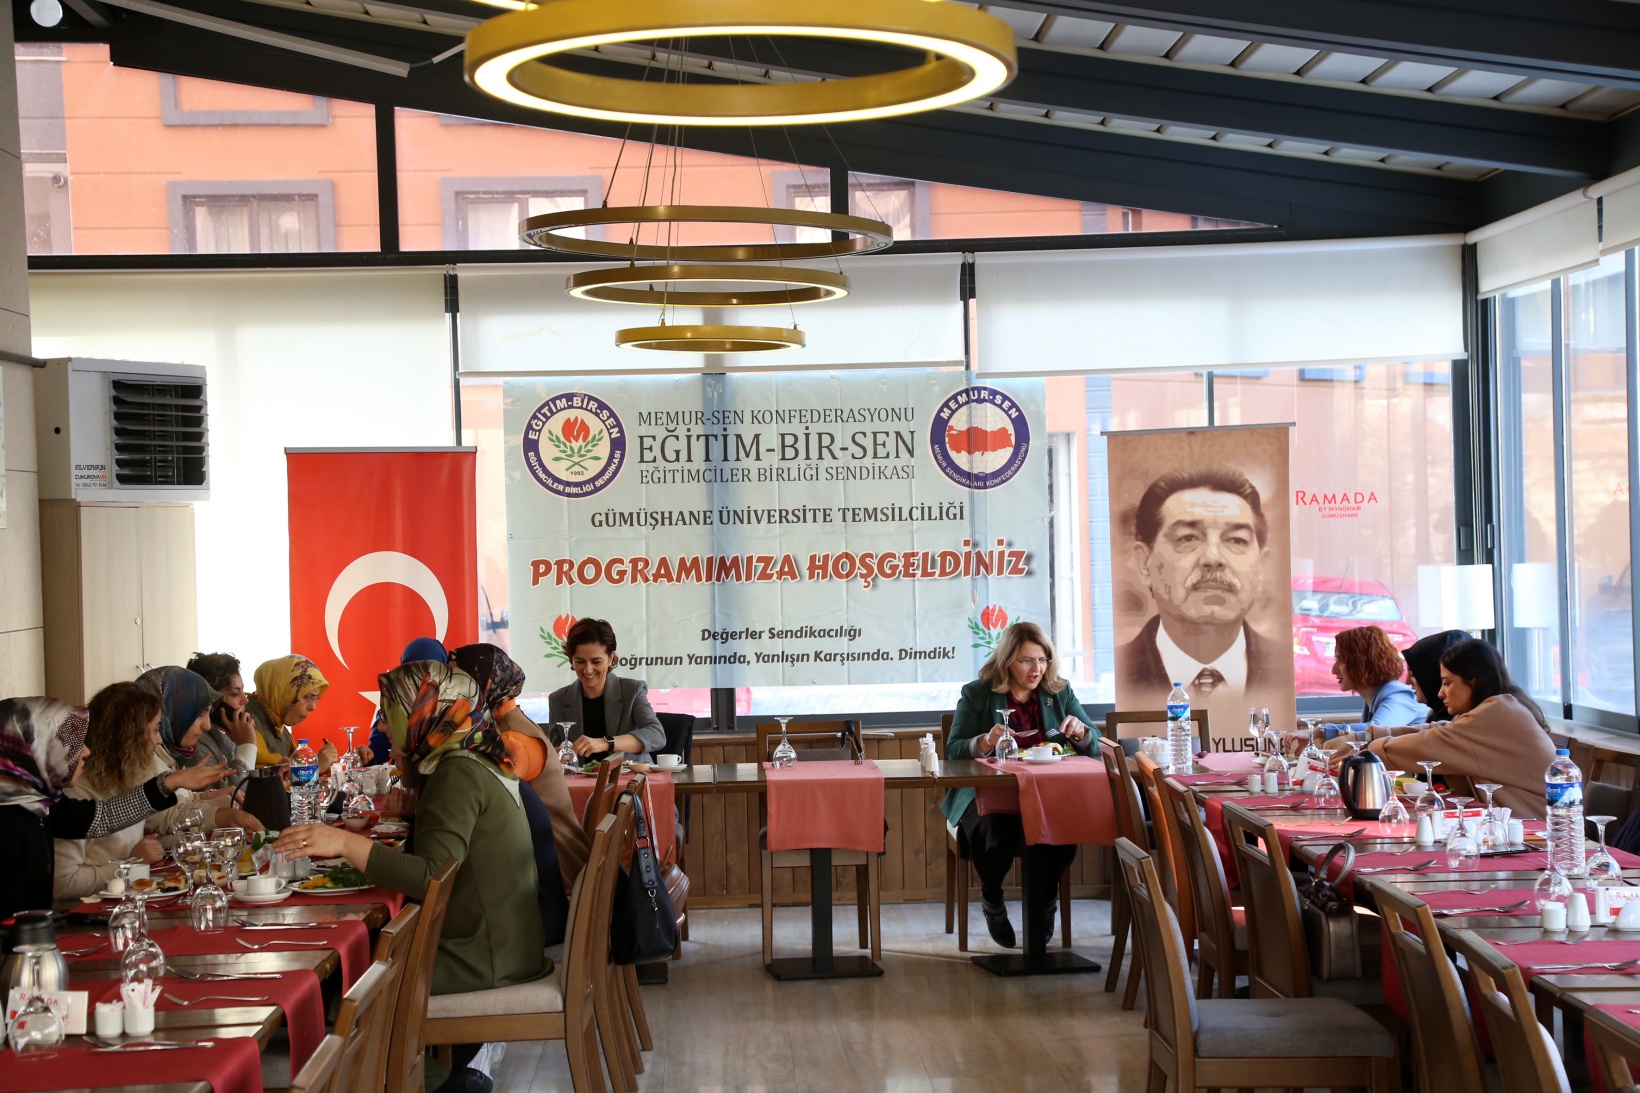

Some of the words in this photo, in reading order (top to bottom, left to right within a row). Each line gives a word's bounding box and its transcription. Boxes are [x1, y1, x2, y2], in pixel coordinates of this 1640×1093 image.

[528, 396, 621, 440] EĞİTİM-BİR-SEN
[638, 410, 744, 426] MEMUR-SEN
[750, 407, 915, 425] KONFEDERASYONU
[940, 390, 1019, 420] MEMUR-SEN
[638, 426, 916, 464] EĞİTİM-BİR-SEN
[528, 451, 565, 492] EĞİTİMCİLER
[565, 482, 594, 494] BİRLİĞİ
[594, 450, 622, 488] SENDİKASI
[640, 465, 752, 484] EĞİTİMCİLER
[757, 463, 820, 482] BİRLİĞİ
[825, 463, 916, 481] SENDİKASI
[933, 444, 947, 468] MEMUR
[986, 442, 1028, 487] KONFEDERASYONU
[1295, 490, 1378, 506] RAMADA
[591, 507, 713, 530] GÜMÜŞHANE
[718, 504, 833, 526] ÜNİVERSİTE
[838, 501, 965, 523] TEMSİLCİLİĞİ
[530, 553, 800, 588] PROGRAMIMIZA
[806, 537, 1028, 590] HOŞGELDİNİZ
[700, 627, 765, 644] Değerler
[768, 625, 862, 642] Sendikacılığı
[687, 651, 751, 666] Yanında,
[755, 650, 810, 667] Yanlışın
[814, 648, 893, 667] Karşısında.
[898, 646, 956, 661] Dimdik!
